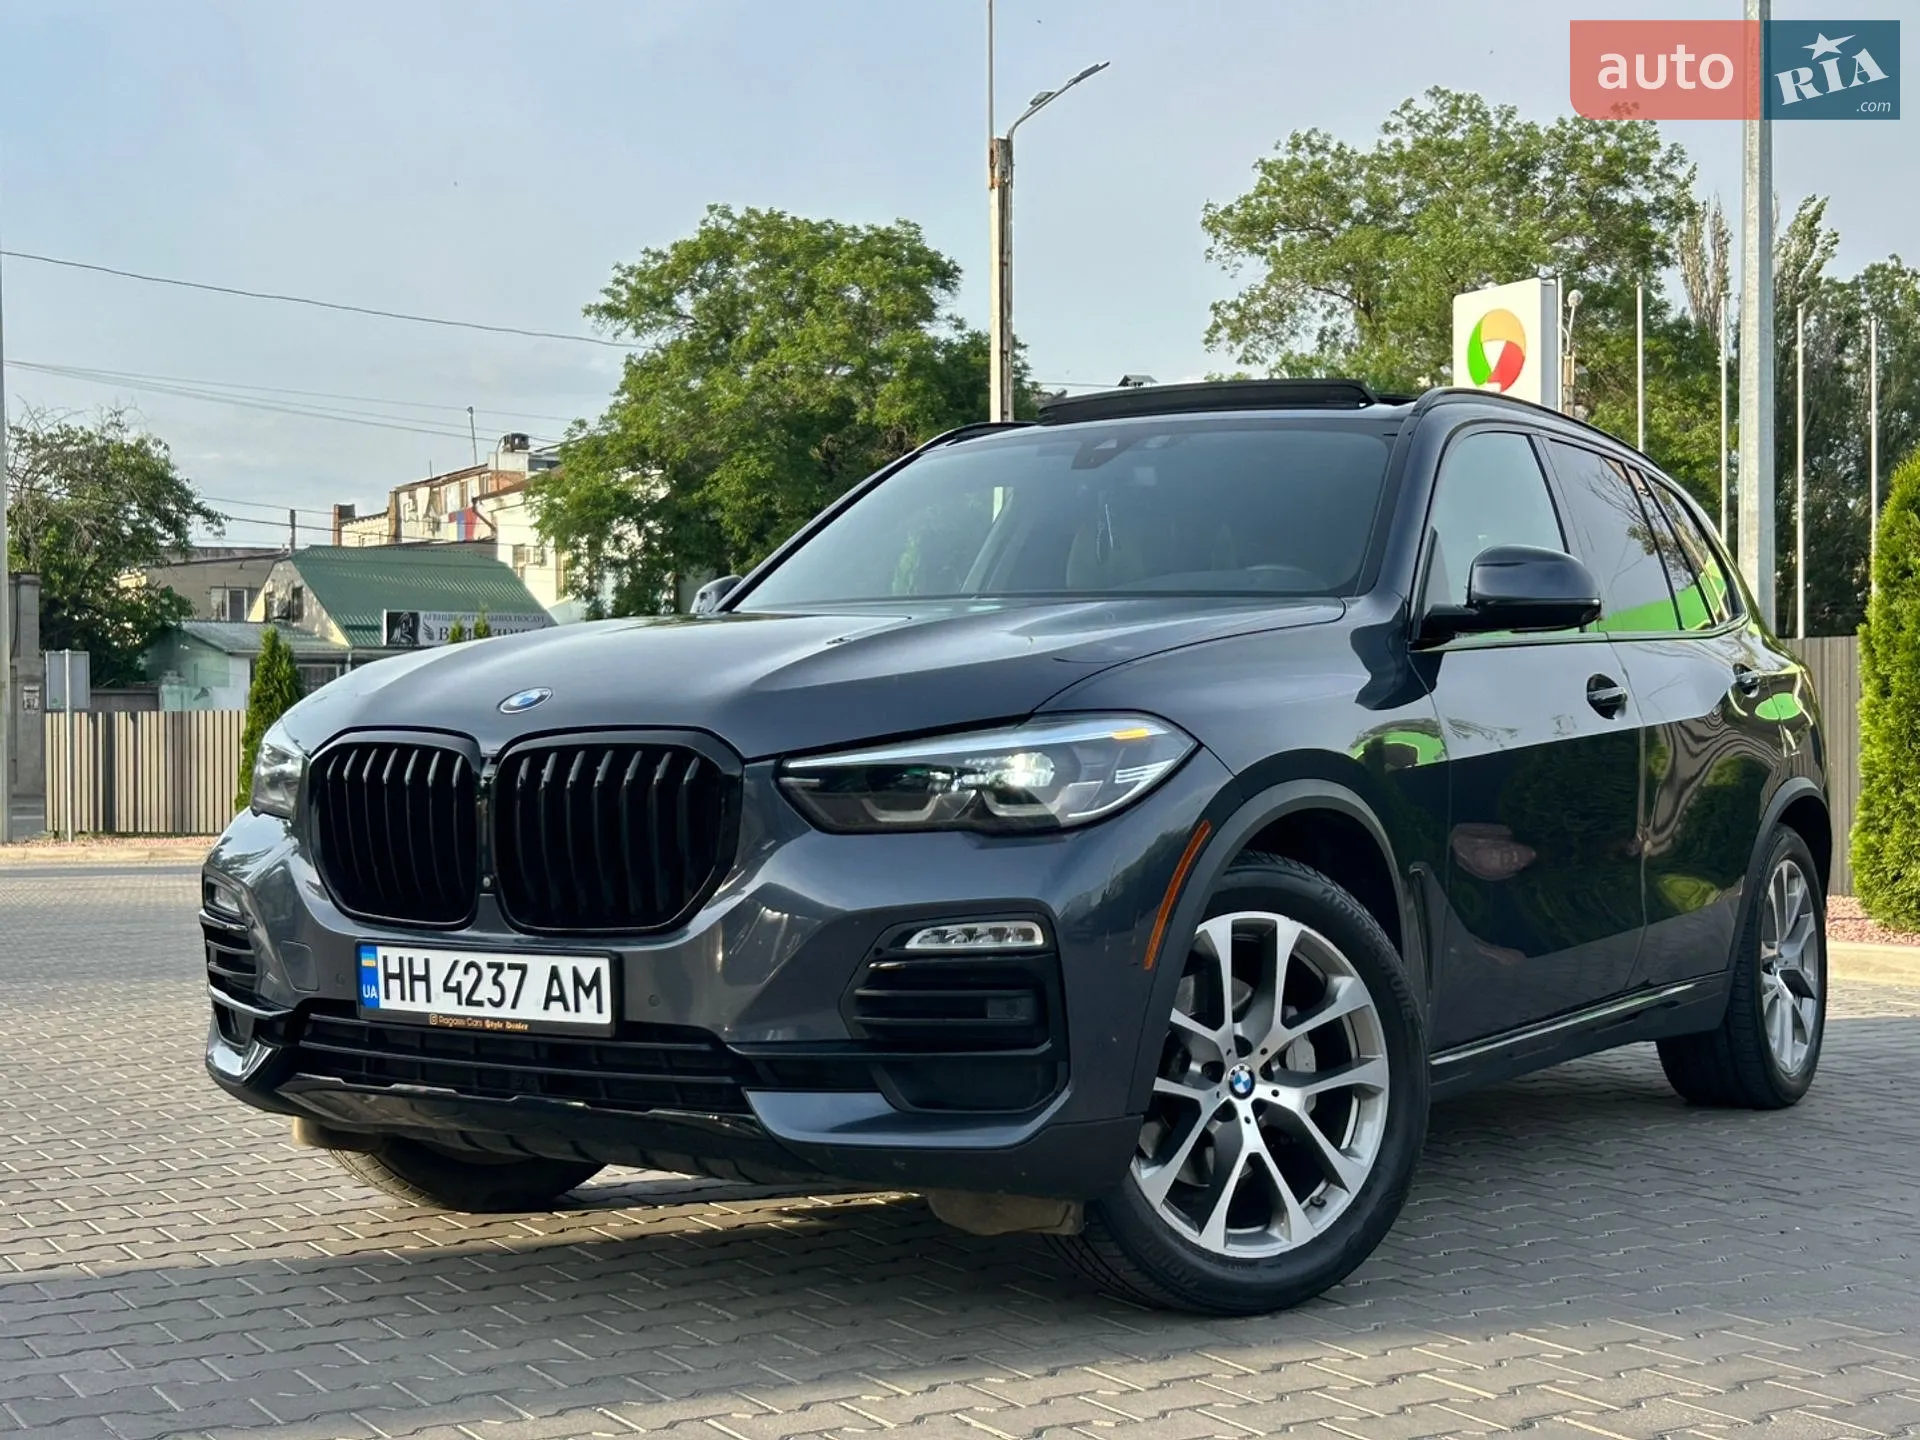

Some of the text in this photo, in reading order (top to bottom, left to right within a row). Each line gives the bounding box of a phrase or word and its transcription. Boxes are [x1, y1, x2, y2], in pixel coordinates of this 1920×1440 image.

[362, 984, 378, 998] UA
[382, 955, 603, 1014] HH 4237 AM
